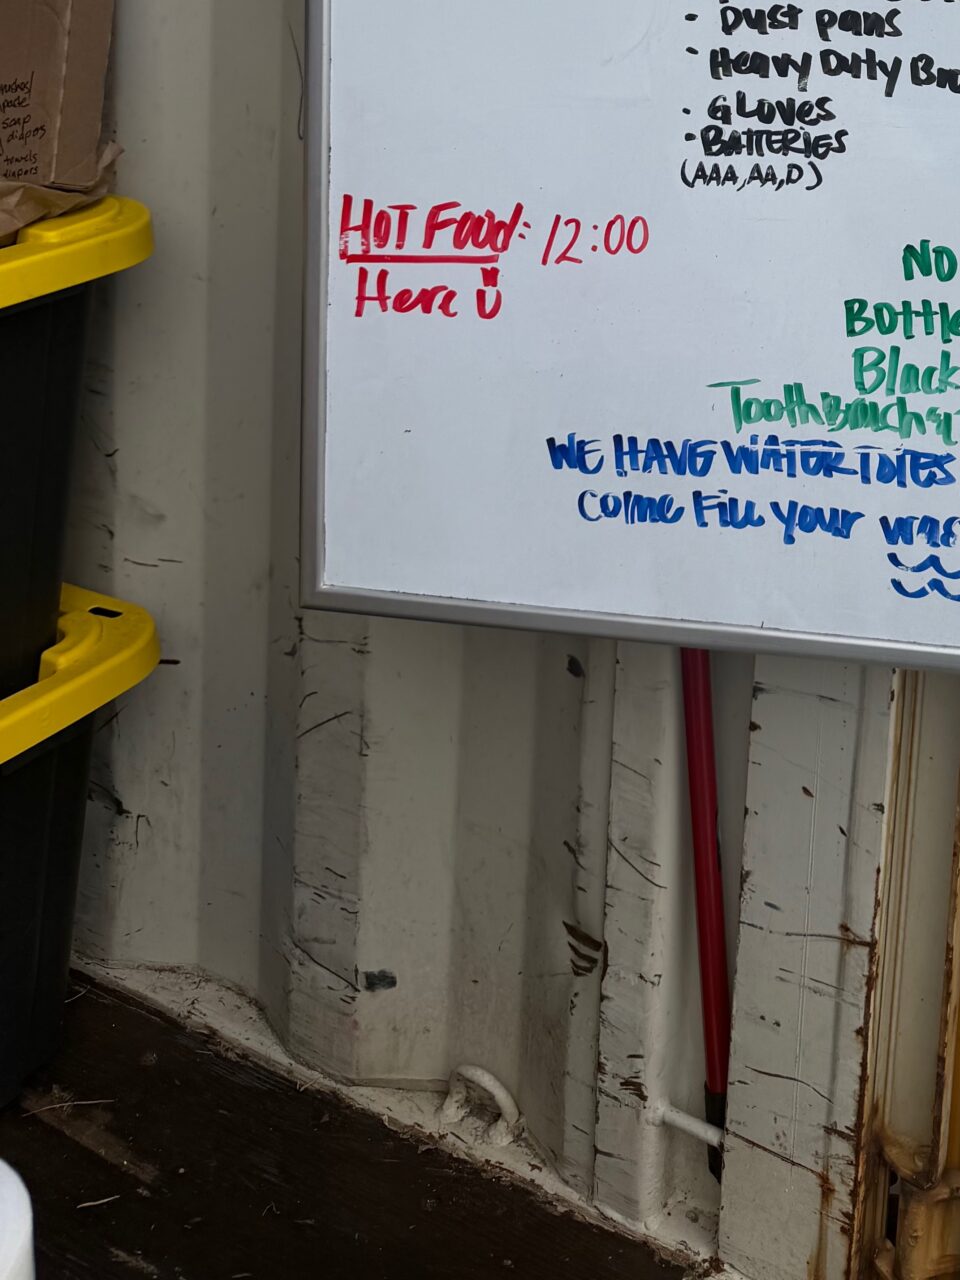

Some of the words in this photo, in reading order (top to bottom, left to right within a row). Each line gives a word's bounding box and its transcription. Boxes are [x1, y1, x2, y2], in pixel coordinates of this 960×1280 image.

[541, 213, 649, 266] 12:00
[902, 238, 959, 282] NO
[354, 266, 458, 318] Here
[546, 432, 605, 475] WE
[613, 433, 718, 478] HAVE
